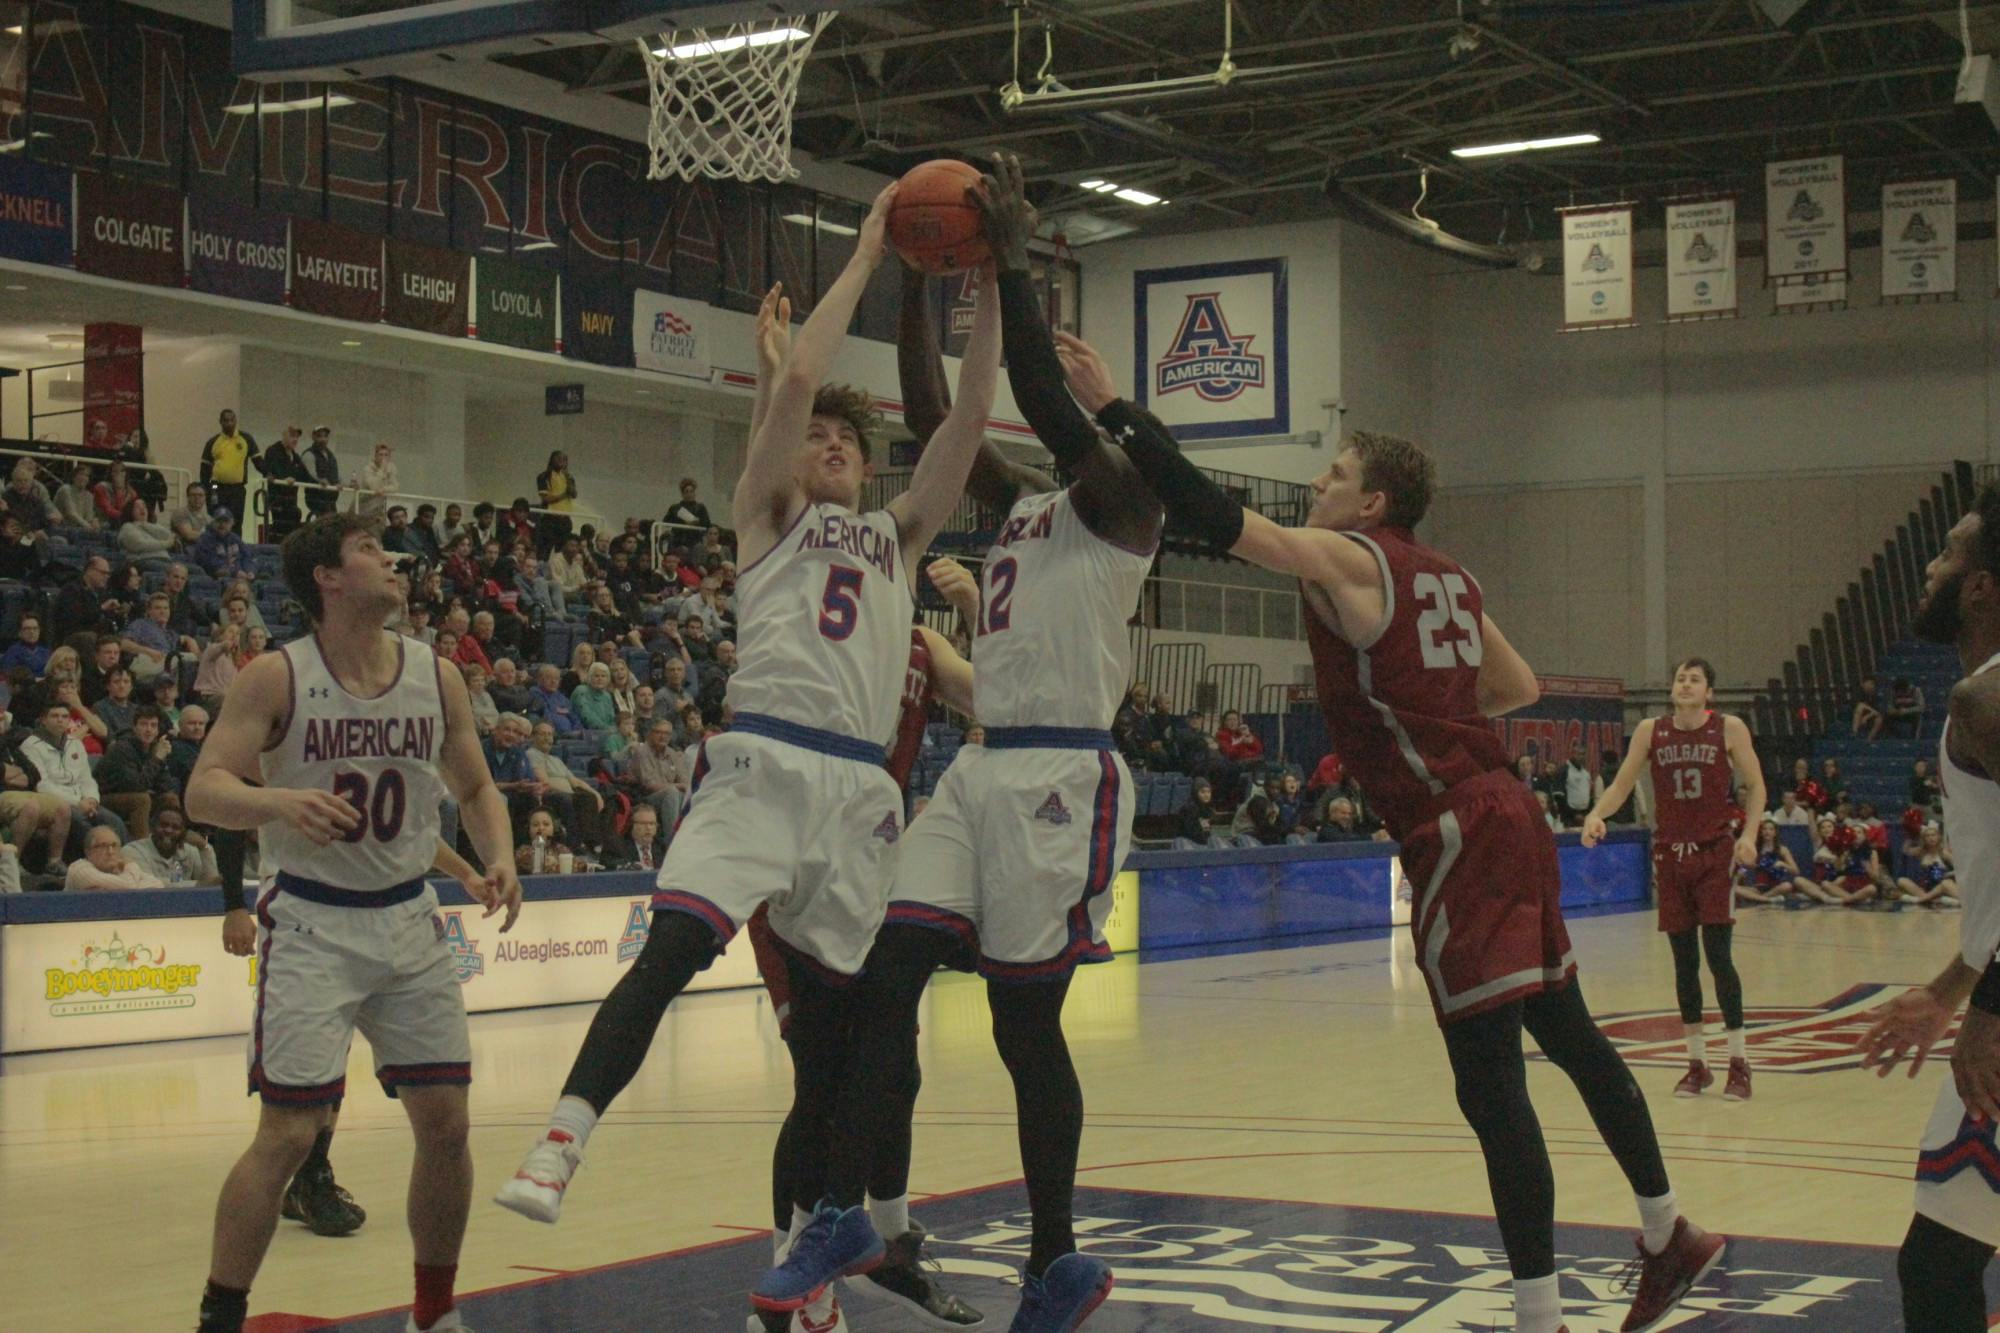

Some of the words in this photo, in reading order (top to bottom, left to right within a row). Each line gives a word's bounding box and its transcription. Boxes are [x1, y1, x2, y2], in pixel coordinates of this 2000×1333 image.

[94, 216, 173, 253] COLGATE
[192, 230, 230, 262] HOLY
[237, 240, 286, 272] CROSS
[297, 253, 378, 291] LAFAYETTE
[403, 272, 456, 304] LEHIGH
[492, 289, 543, 319] LOYOLA
[582, 311, 615, 336] NAVY
[650, 331, 696, 349] PATRIOT
[650, 343, 696, 360] LEAGUE
[1165, 361, 1256, 383] AMERICAN
[818, 563, 865, 642] 5
[1413, 572, 1483, 669] 25
[303, 716, 435, 763] AMERICAN
[1656, 743, 1718, 767] COLGATE
[1673, 768, 1702, 799] 13
[333, 768, 406, 844] 30
[494, 938, 608, 963] AUeagles.com
[620, 943, 646, 958] AMER
[45, 965, 201, 999] Booeymonger
